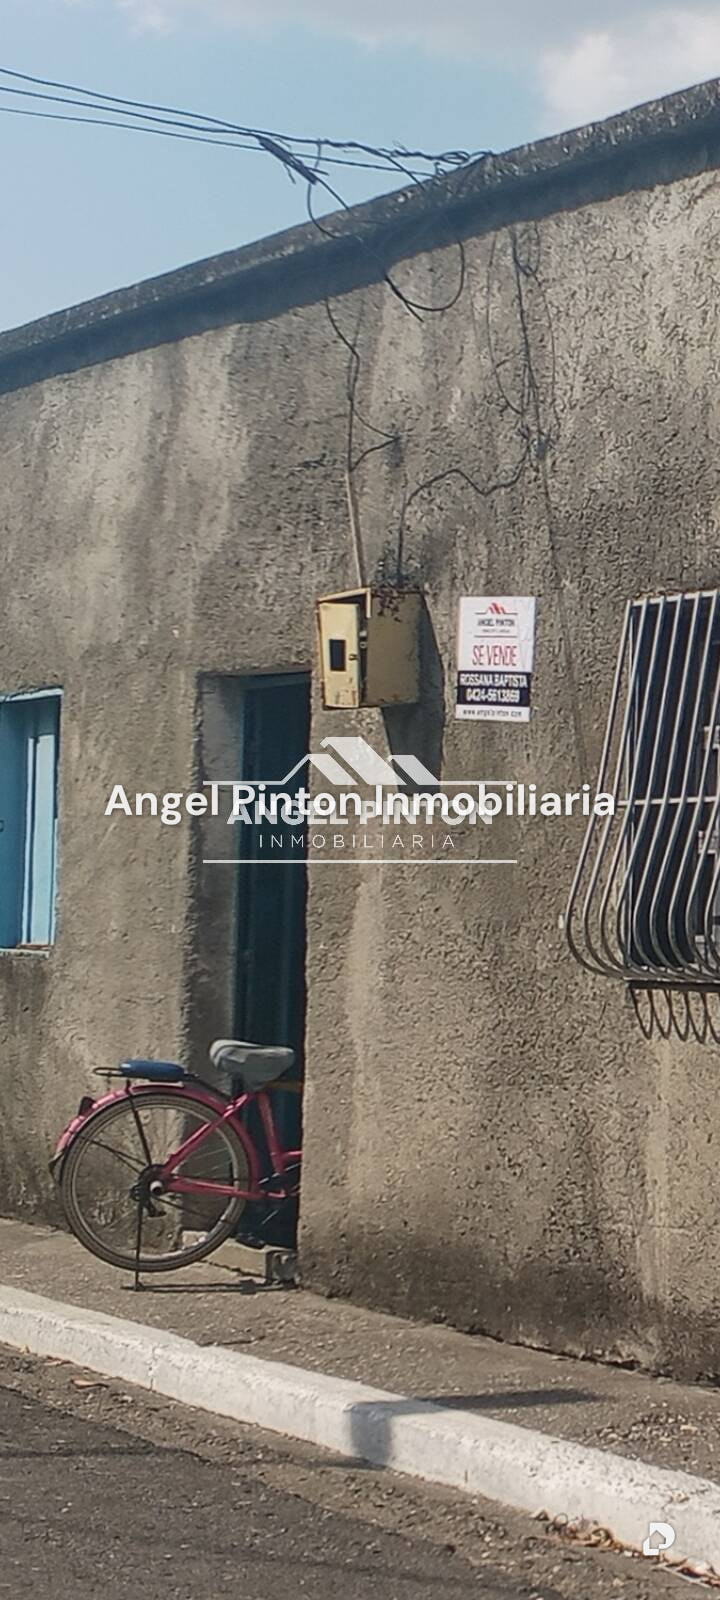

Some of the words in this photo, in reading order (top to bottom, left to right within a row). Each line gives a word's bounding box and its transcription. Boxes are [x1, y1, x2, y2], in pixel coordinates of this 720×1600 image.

[472, 645, 484, 666] SE
[487, 645, 517, 666] VENDE
[460, 673, 493, 686] ROSSANA
[494, 674, 528, 688] BAPTISTA
